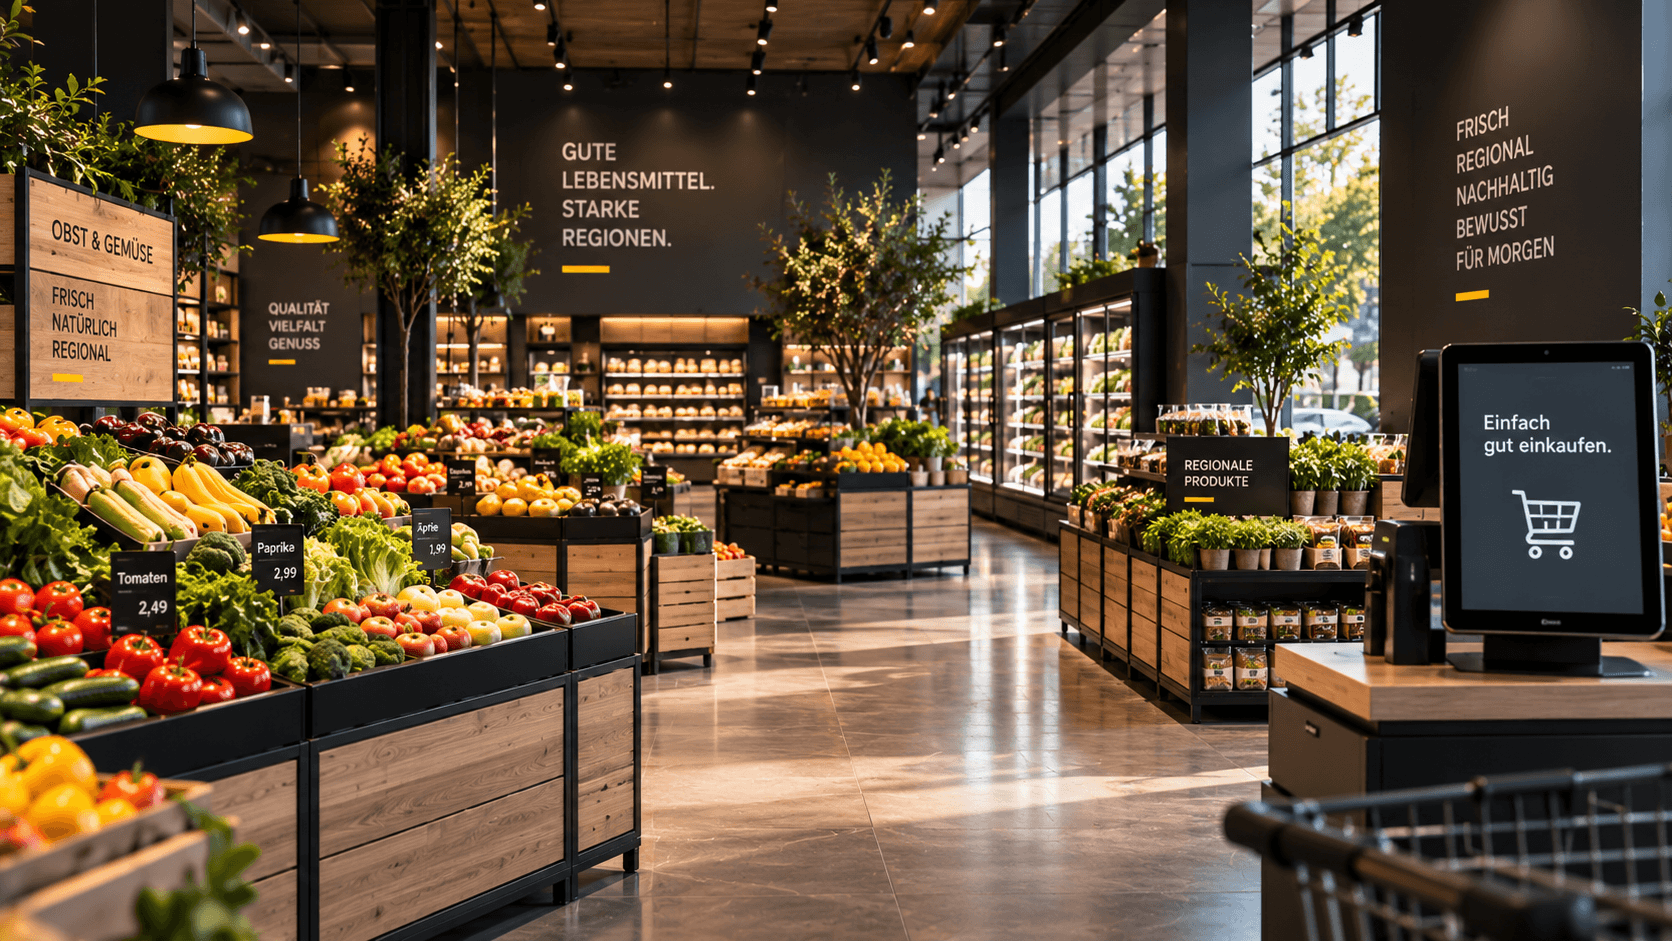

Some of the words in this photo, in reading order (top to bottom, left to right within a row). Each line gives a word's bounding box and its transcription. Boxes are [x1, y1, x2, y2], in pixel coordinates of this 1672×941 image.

[1456, 105, 1510, 142] FRISCH
[561, 141, 617, 162] GUTE
[1456, 134, 1534, 174] REGIONAL
[562, 170, 716, 190] LEBENSMITTEL.
[1456, 164, 1554, 207] NACHHALTIG
[562, 199, 640, 219] STARKE
[1456, 205, 1528, 240] BEWUSST
[51, 219, 88, 248] OBST
[91, 230, 101, 251] &
[104, 236, 154, 265] GEMÜSE
[562, 228, 672, 247] REGIONEN.
[1456, 245, 1484, 272] FÜR
[1487, 235, 1555, 267] MORGEN
[52, 286, 95, 310] FRISCH
[268, 299, 330, 316] QUALITÄT
[52, 312, 117, 338] NATÜRLICH
[268, 319, 326, 333] VIELFALT
[52, 339, 112, 362] REGIONAL
[268, 337, 321, 350] GENUSS
[1484, 414, 1550, 431] Einfach
[1484, 438, 1514, 457] gut
[1518, 437, 1612, 454] einkaufen.
[1184, 459, 1253, 472] REGIONALE
[1184, 475, 1249, 488] PRODUKTE
[429, 543, 446, 556] 1,99
[116, 571, 168, 585] Tomaten
[273, 566, 297, 582] 2,99
[138, 599, 168, 618] 2,49
